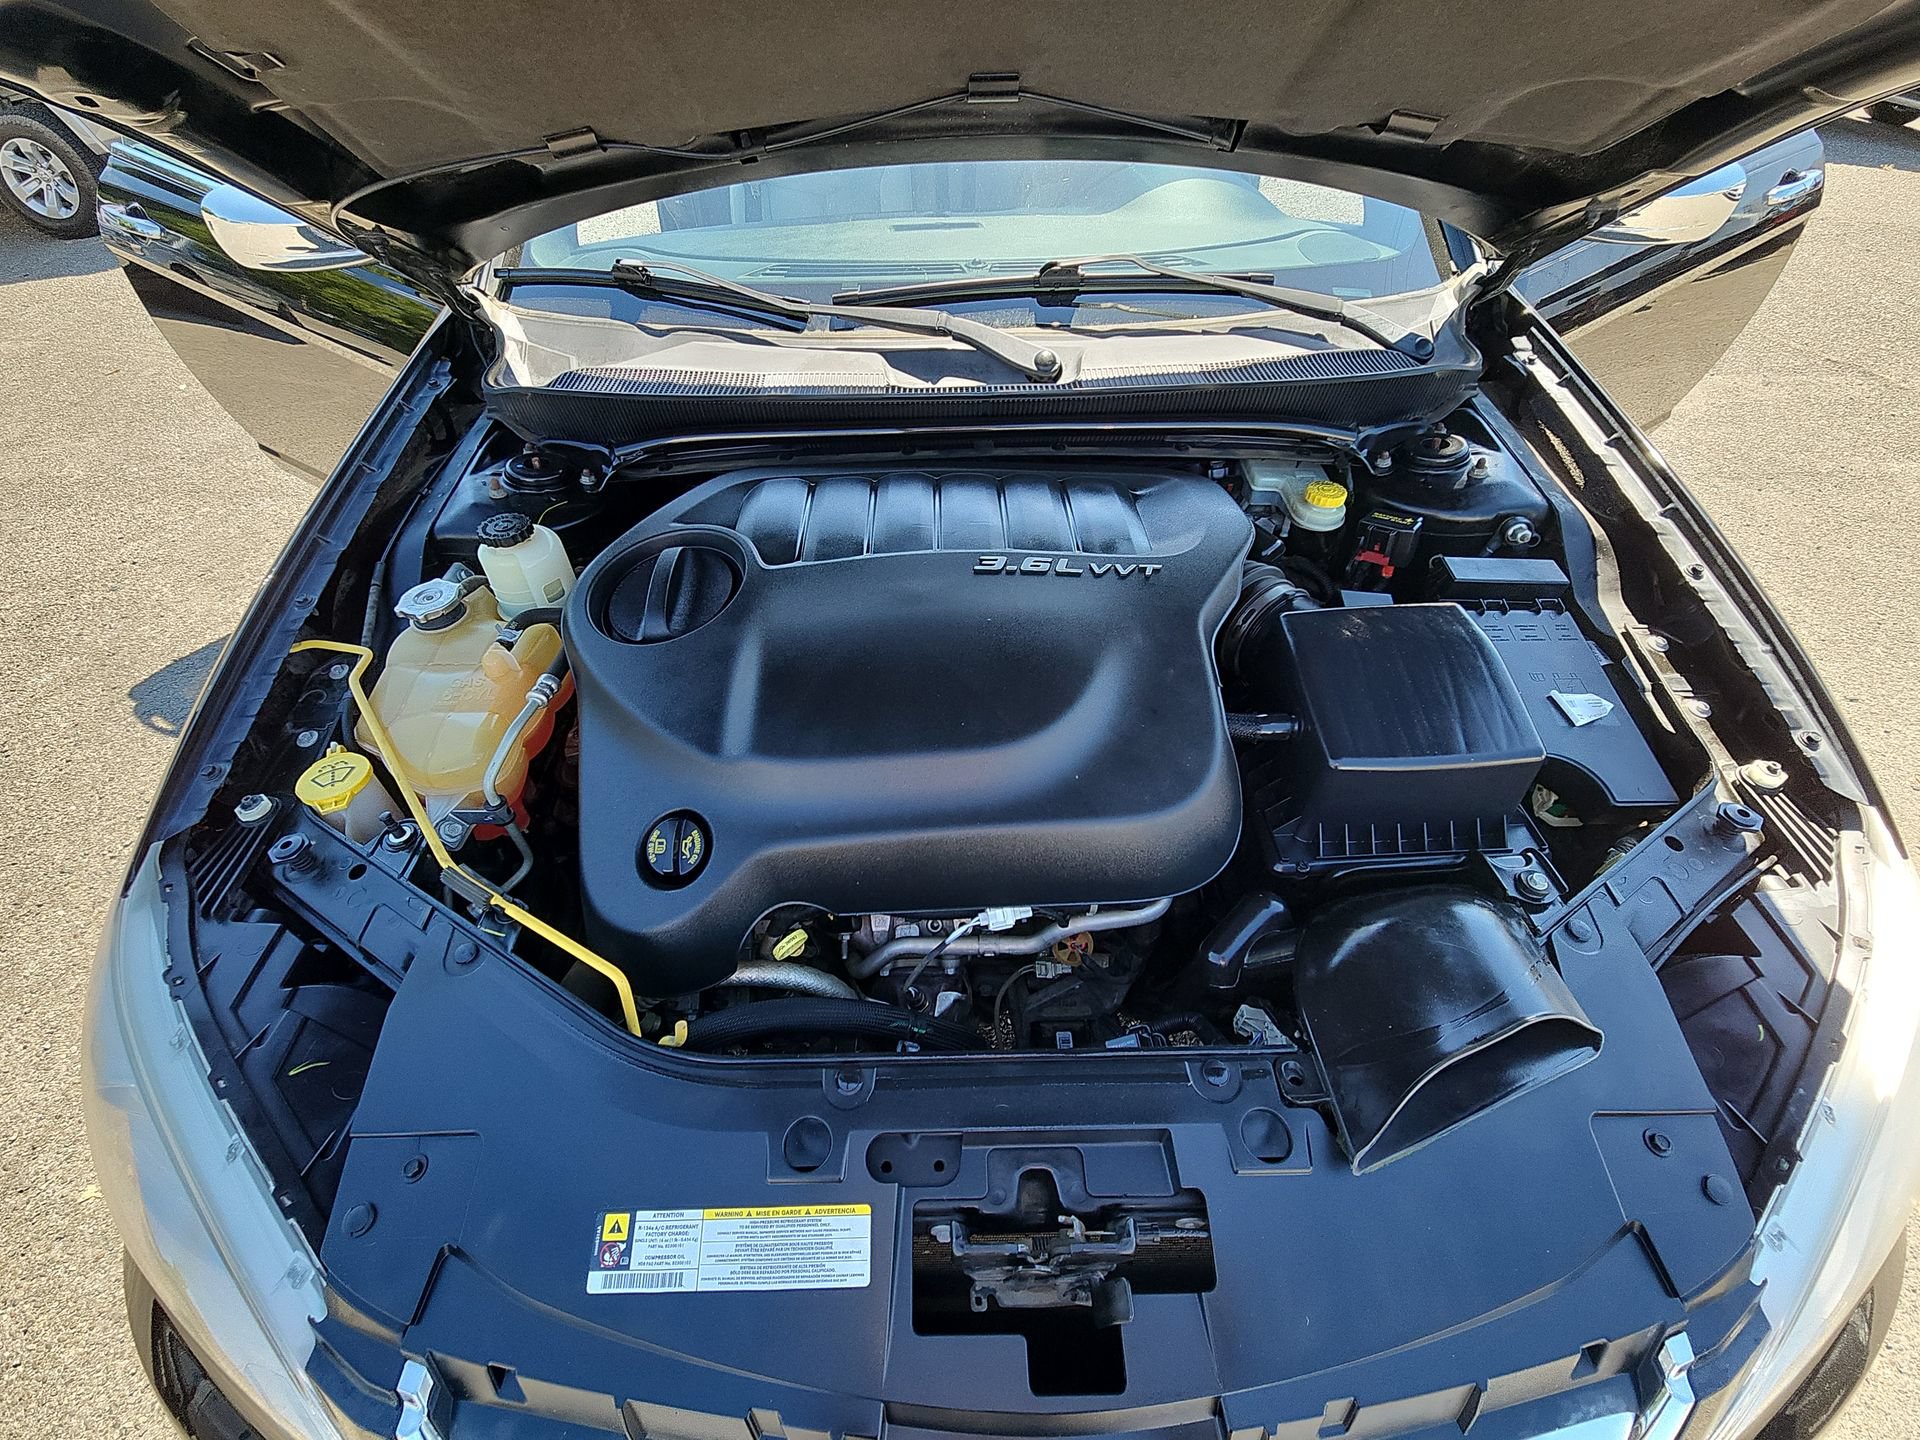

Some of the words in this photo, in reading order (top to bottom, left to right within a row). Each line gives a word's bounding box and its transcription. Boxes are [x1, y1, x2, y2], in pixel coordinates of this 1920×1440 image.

[973, 555, 1084, 577] 3.6L
[1089, 562, 1163, 577] VVT
[691, 829, 701, 854] ENGINE
[687, 853, 699, 865] OIL
[781, 1208, 802, 1216] GARDE
[814, 1207, 857, 1215] ADVERTENCIA
